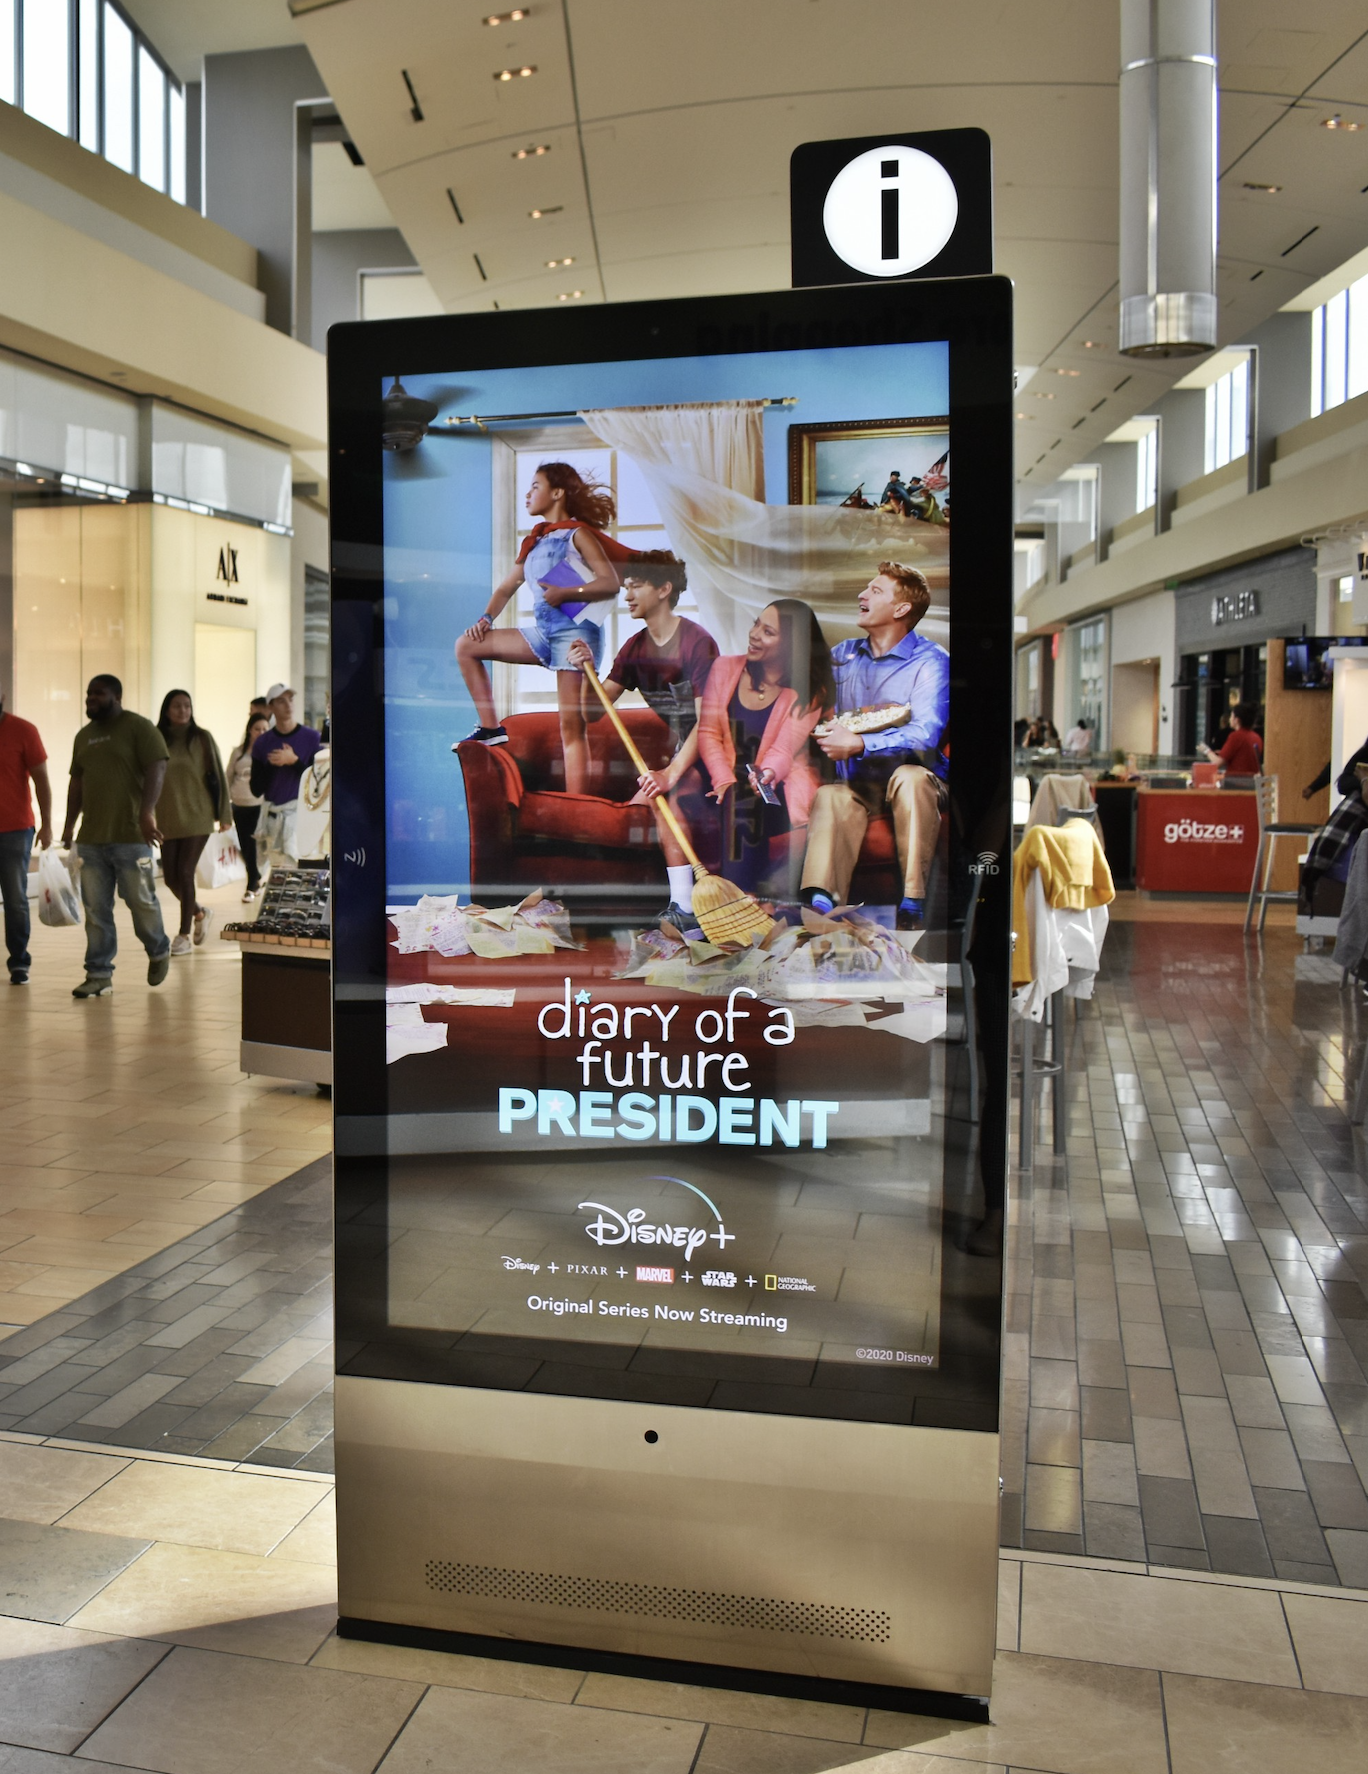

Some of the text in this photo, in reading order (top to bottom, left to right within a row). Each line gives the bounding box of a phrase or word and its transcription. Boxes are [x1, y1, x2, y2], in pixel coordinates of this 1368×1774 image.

[968, 864, 1000, 876] RFID
[538, 977, 796, 1046] diary of a
[576, 1041, 752, 1092] future
[498, 1087, 840, 1149] PRESIDENT
[566, 1264, 609, 1276] PIXAR
[636, 1266, 674, 1283] MARVEL
[701, 1270, 737, 1280] STAR
[778, 1276, 808, 1285] NATIONAL
[701, 1278, 737, 1288] WARS
[777, 1283, 816, 1292] GEOGRAPHIC
[527, 1295, 788, 1333] Original Series Now Streaming
[896, 1351, 934, 1366] Disney
